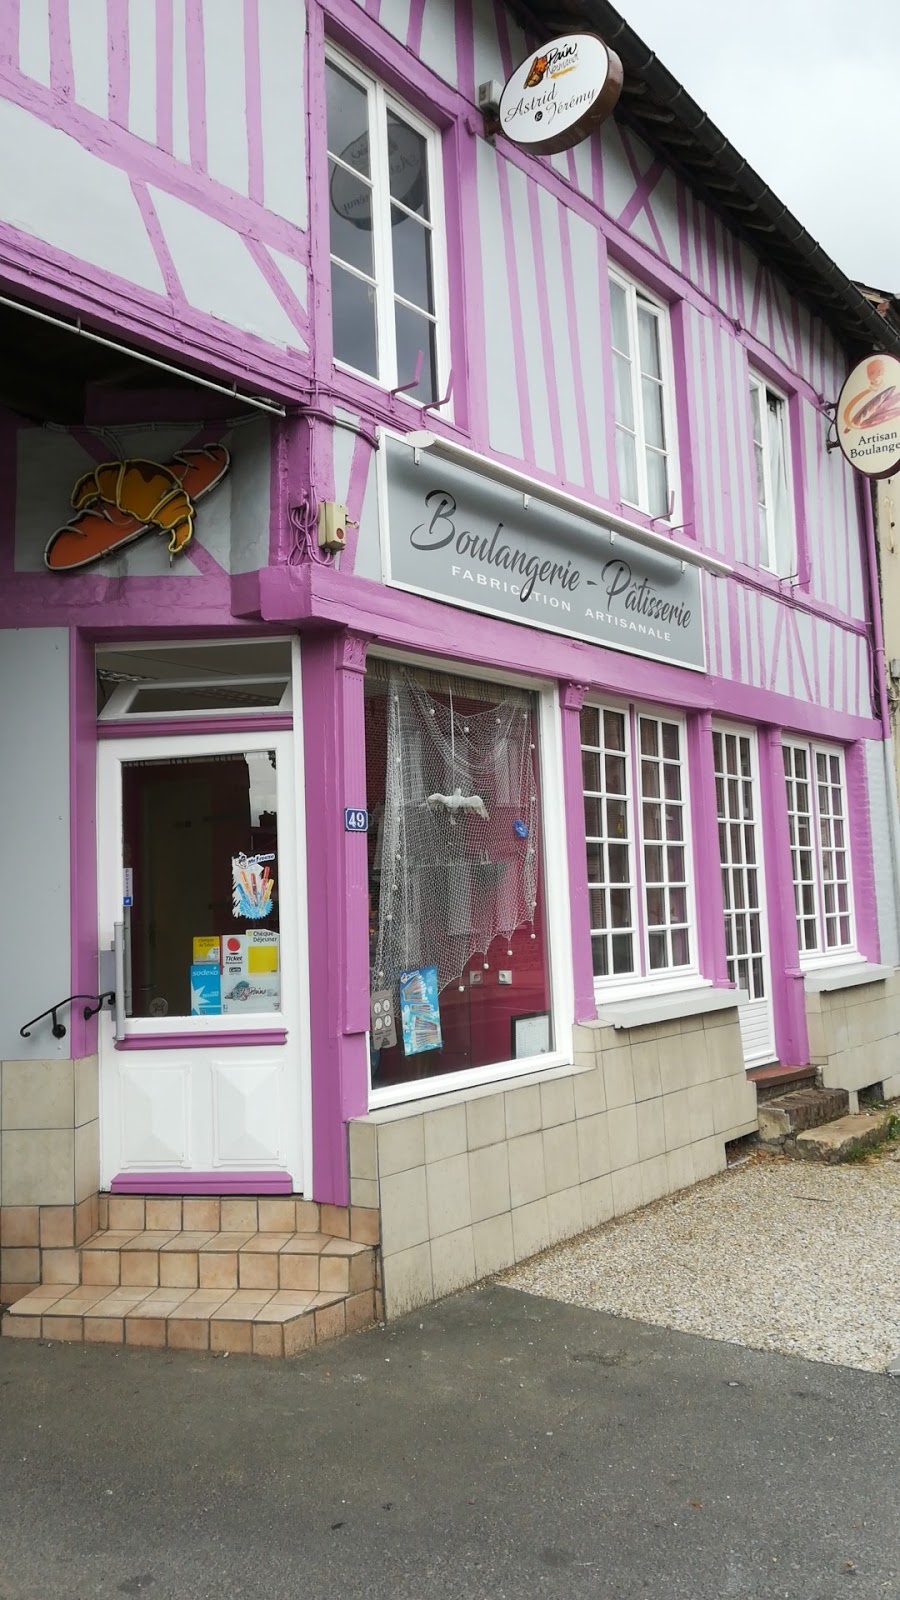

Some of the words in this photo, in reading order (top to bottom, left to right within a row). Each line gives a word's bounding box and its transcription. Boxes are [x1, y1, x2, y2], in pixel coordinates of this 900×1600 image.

[545, 42, 578, 66] Pain
[504, 83, 558, 123] Astrid
[546, 89, 595, 125] Jérémy
[858, 432, 897, 446] Artisan
[409, 489, 580, 603] Boulangerie
[601, 559, 692, 629] Pâtisserie
[584, 607, 673, 643] ARTISANALE
[348, 811, 365, 828] 49
[192, 969, 218, 977] sodexo
